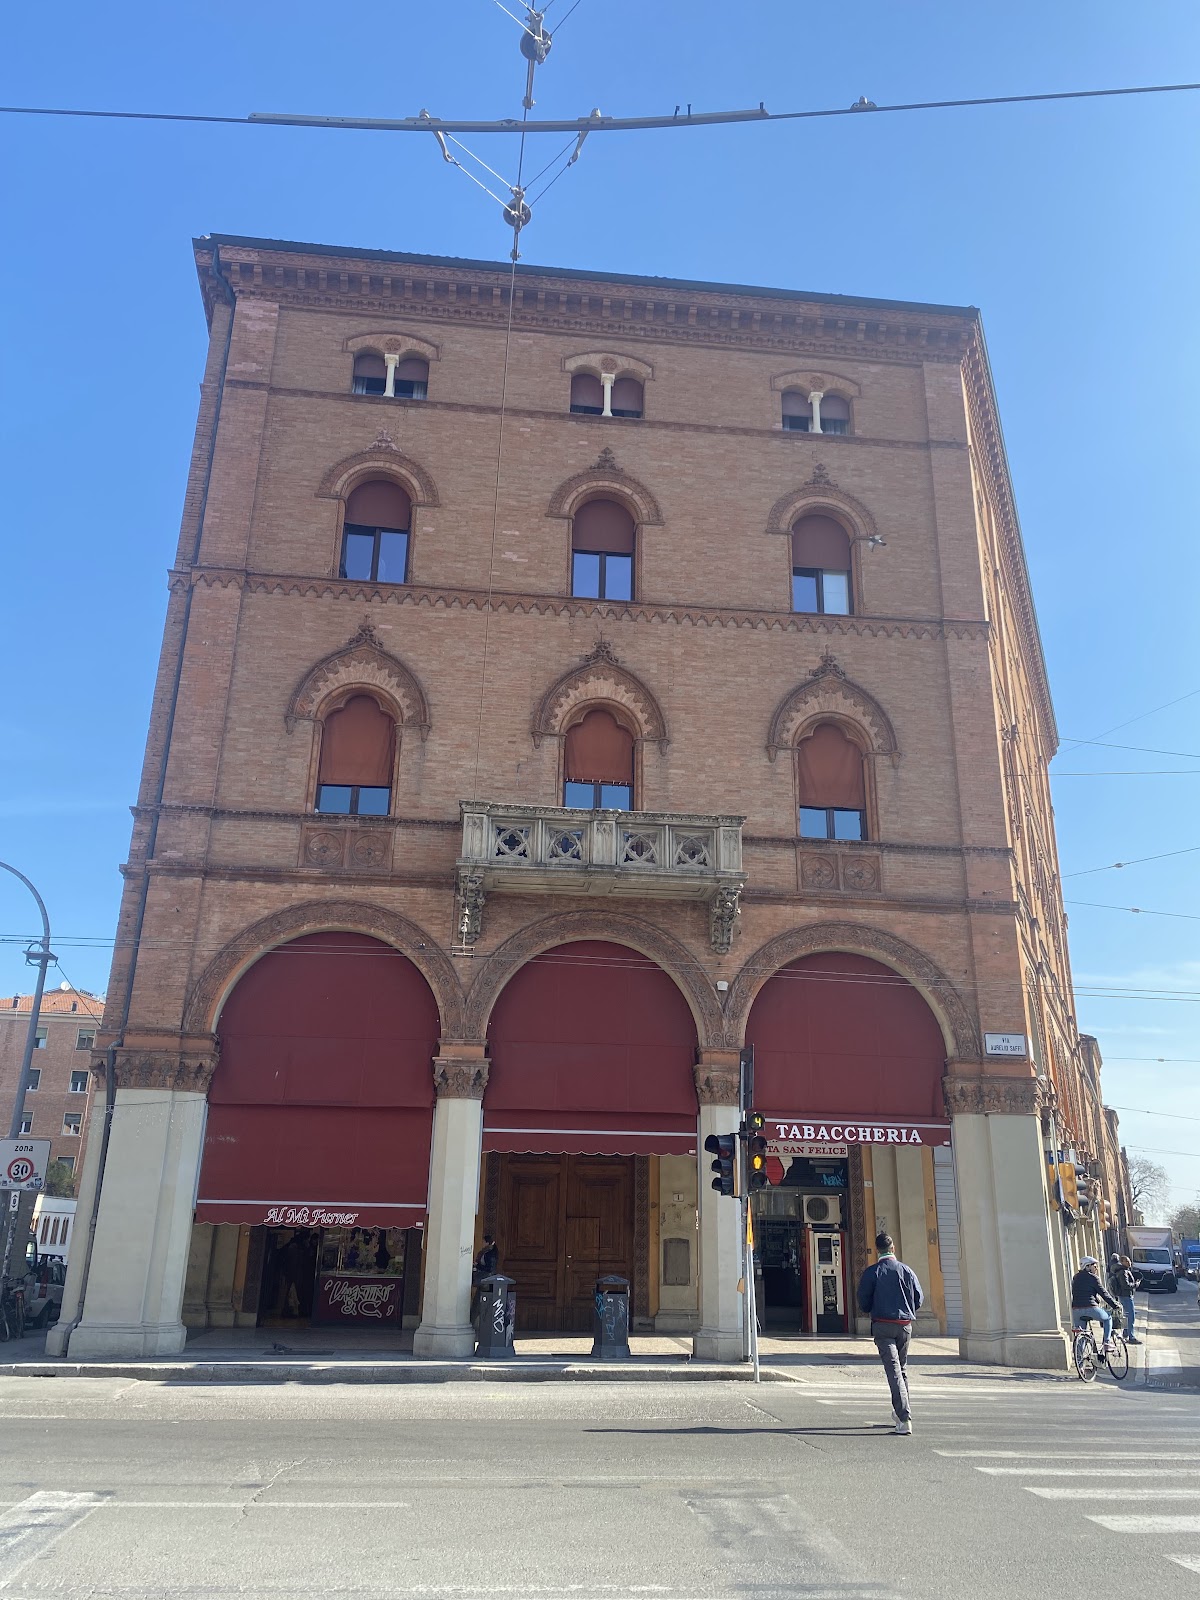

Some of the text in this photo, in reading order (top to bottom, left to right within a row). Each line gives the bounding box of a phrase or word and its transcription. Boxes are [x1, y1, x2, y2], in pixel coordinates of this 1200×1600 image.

[754, 1117, 762, 1127] 4
[776, 1124, 923, 1143] TABACCHERIA
[808, 1147, 847, 1155] FELICE
[13, 1164, 28, 1176] 30
[263, 1206, 288, 1223] Al
